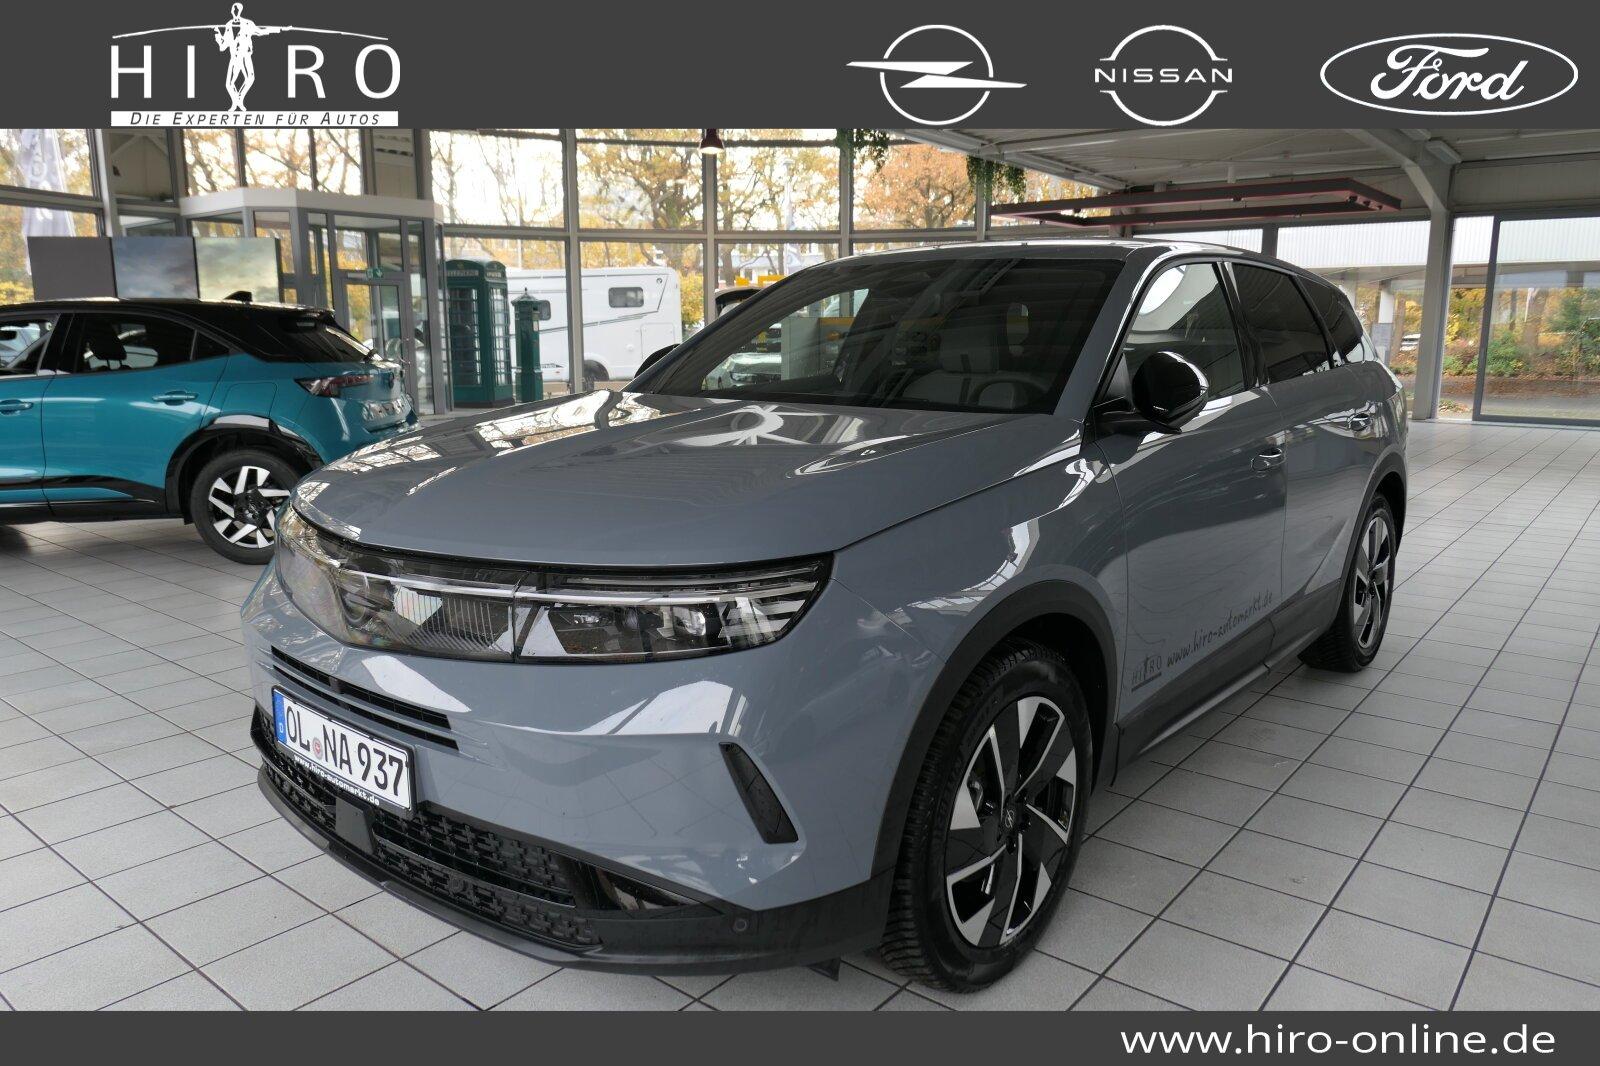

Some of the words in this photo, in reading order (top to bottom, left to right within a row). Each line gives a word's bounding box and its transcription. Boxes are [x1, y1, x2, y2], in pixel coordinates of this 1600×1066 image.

[286, 705, 311, 752] OL
[322, 723, 353, 775] NA
[357, 742, 404, 797] 937
[293, 754, 380, 806] www.hiro-automarkt.de
